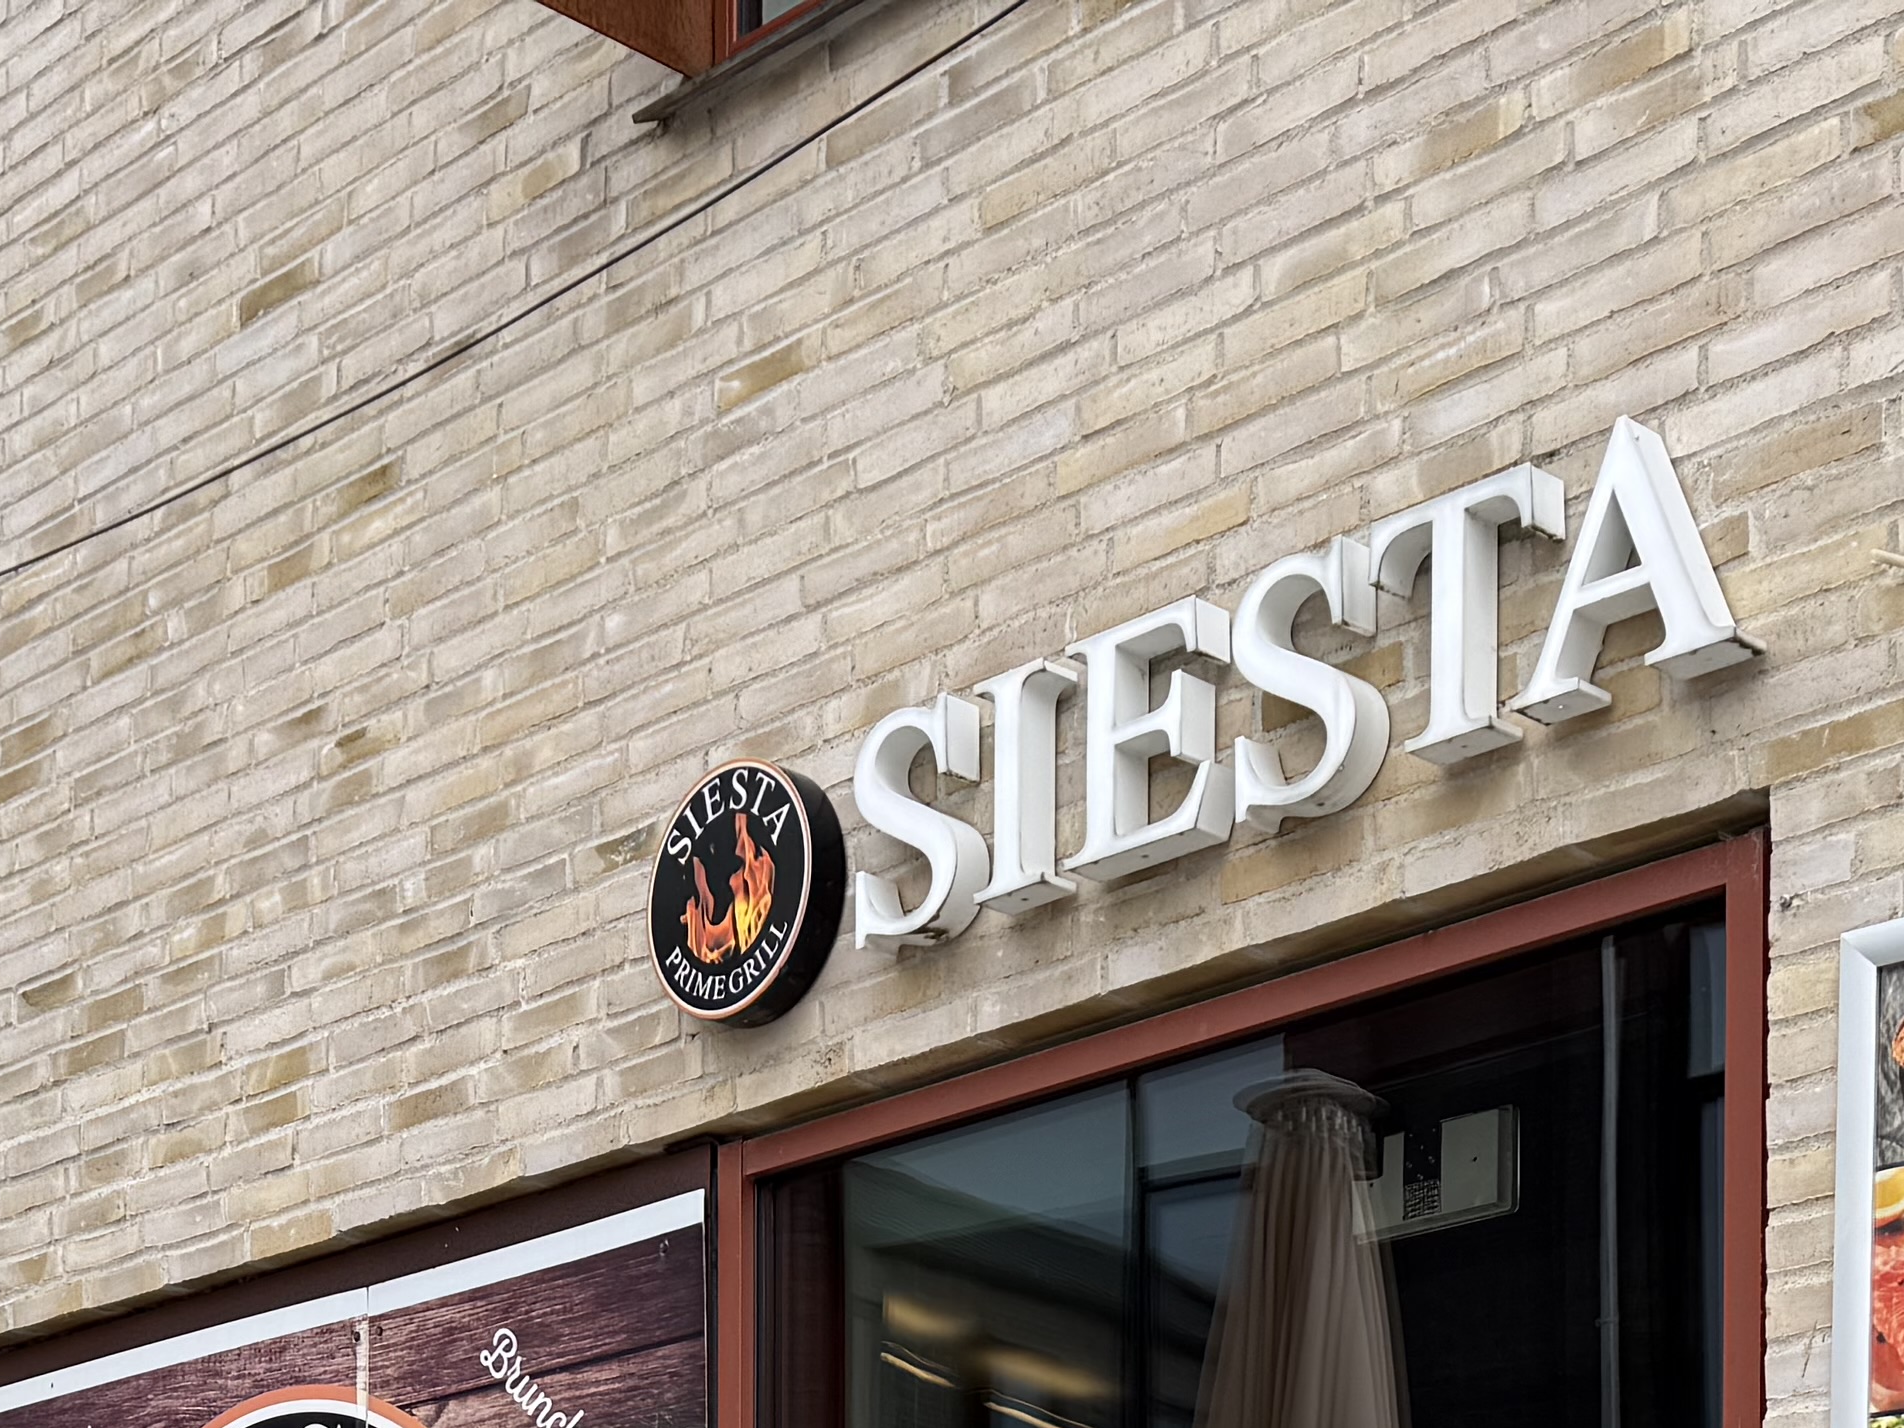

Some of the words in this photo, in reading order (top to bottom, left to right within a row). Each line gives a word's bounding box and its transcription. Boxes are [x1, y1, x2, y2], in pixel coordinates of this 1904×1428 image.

[854, 415, 1765, 950] SIESTA
[668, 768, 791, 864] SIESTA
[665, 946, 727, 1000] PRIME
[728, 921, 788, 994] GRILL
